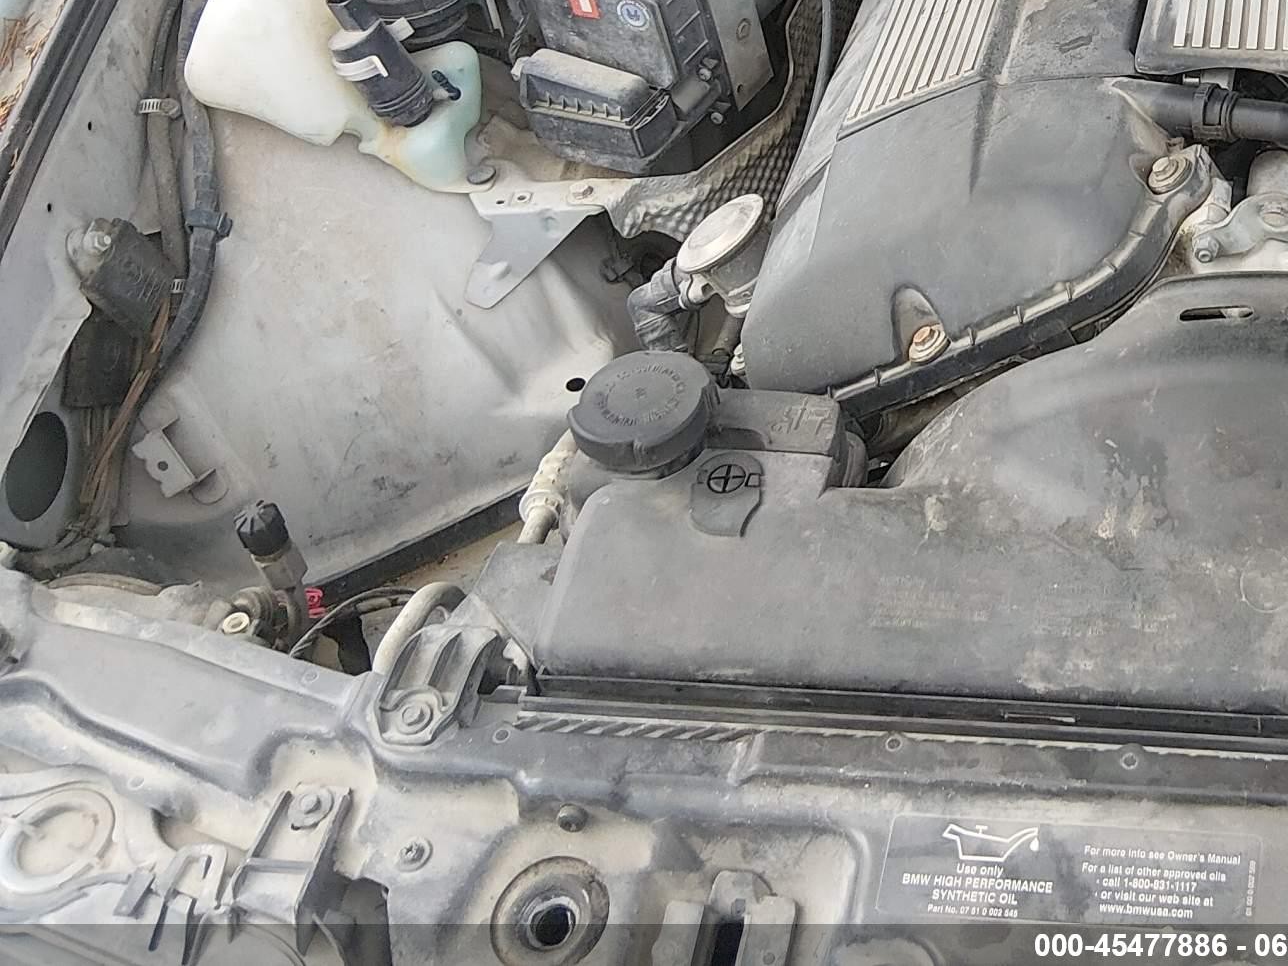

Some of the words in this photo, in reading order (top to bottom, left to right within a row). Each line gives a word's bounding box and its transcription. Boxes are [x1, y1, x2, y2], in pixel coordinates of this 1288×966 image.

[1084, 845, 1100, 856] For
[1102, 848, 1126, 857] more
[1128, 849, 1146, 859] info
[1148, 852, 1165, 860] see
[1167, 851, 1205, 862] Owner's
[1207, 853, 1241, 865] Manual
[956, 863, 976, 874] Use
[980, 865, 1004, 878] only
[1081, 862, 1098, 873] For
[1108, 864, 1123, 875] list
[1124, 866, 1136, 876] of
[1136, 867, 1161, 877] other
[1163, 869, 1207, 882] approved
[1209, 871, 1226, 882] oils
[902, 873, 931, 885] BMW
[934, 875, 962, 887] HIGH
[965, 876, 1053, 893] PERFORMANCE
[1102, 877, 1121, 887] call
[932, 889, 996, 903] SYNTHETIC
[1000, 893, 1018, 905] OIL
[1100, 891, 1112, 900] or
[1114, 890, 1136, 901] visit
[1138, 892, 1157, 902] our
[1158, 894, 1179, 905] web
[1182, 895, 1201, 906] site
[1203, 896, 1214, 907] at
[927, 903, 943, 914] Part
[1099, 903, 1194, 919] www.bmwusa.com
